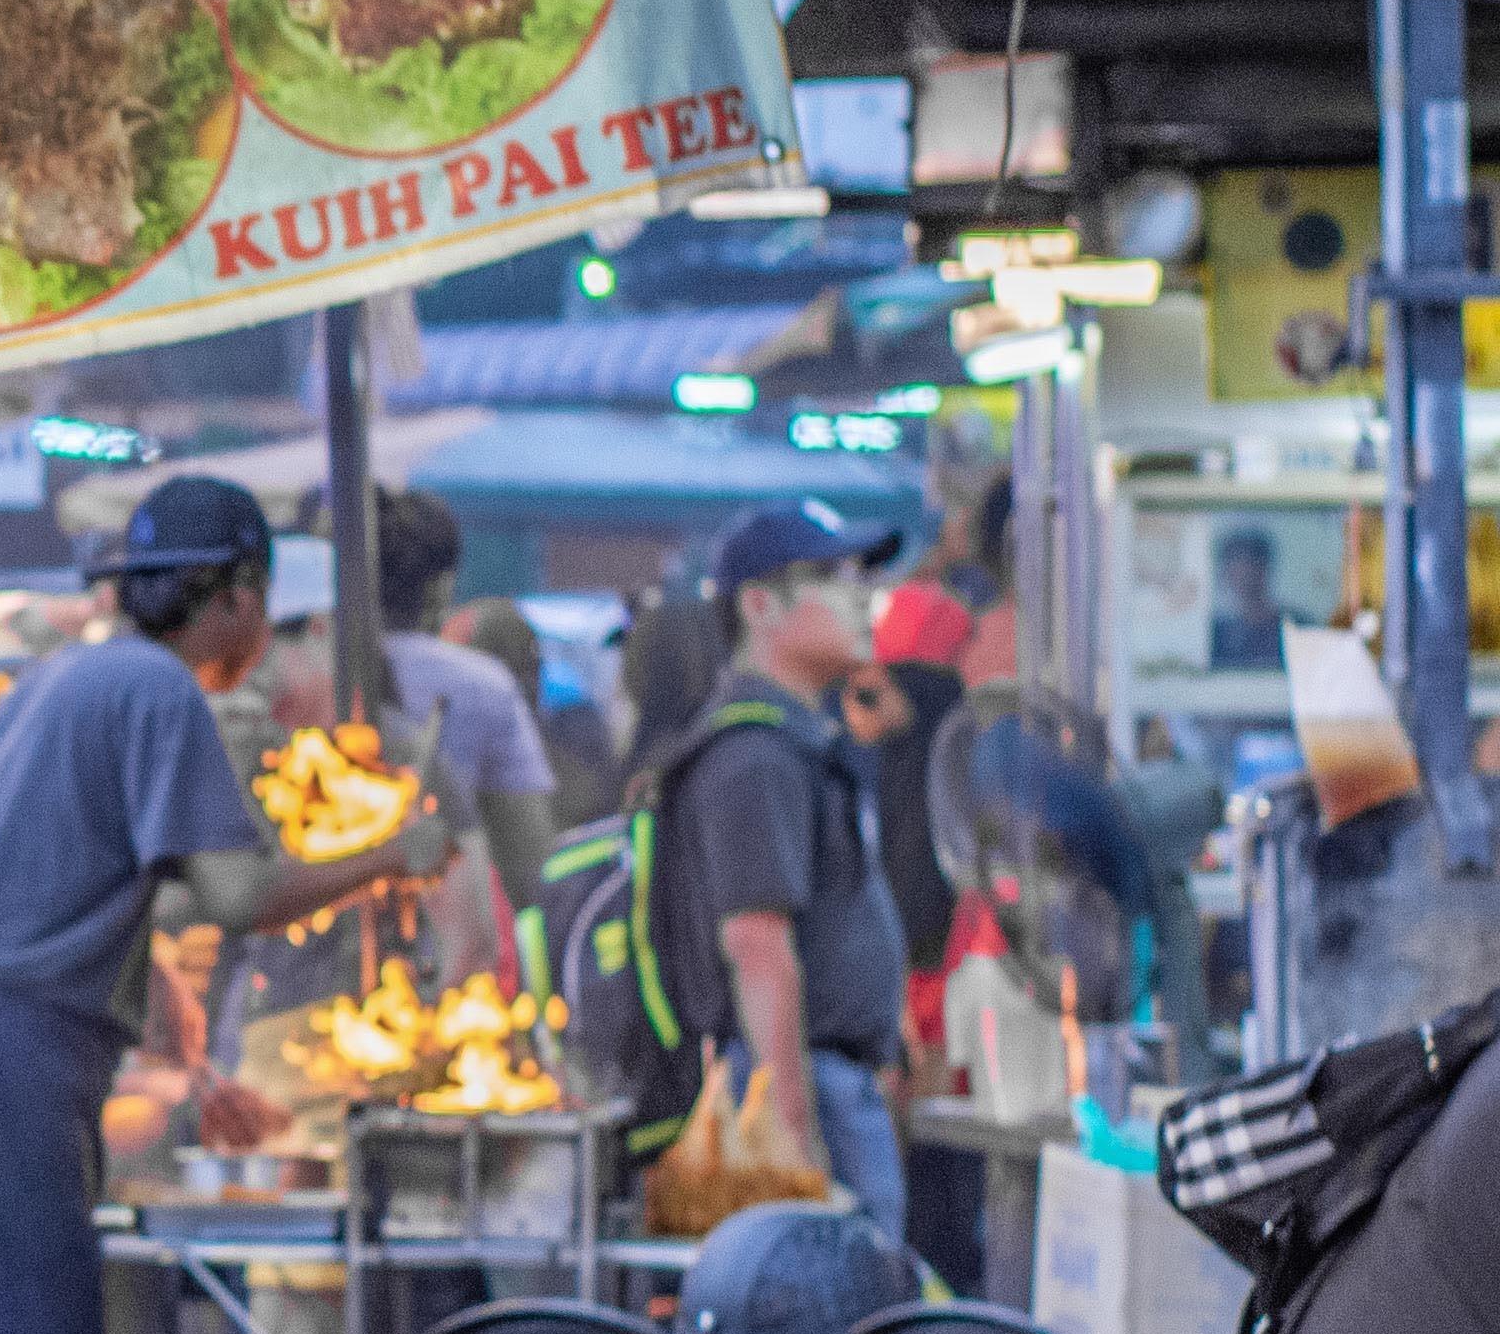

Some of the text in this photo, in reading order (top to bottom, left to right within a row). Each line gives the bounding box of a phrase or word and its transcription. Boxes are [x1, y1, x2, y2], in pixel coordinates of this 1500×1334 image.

[208, 85, 757, 280] KUIH PAI TEE
